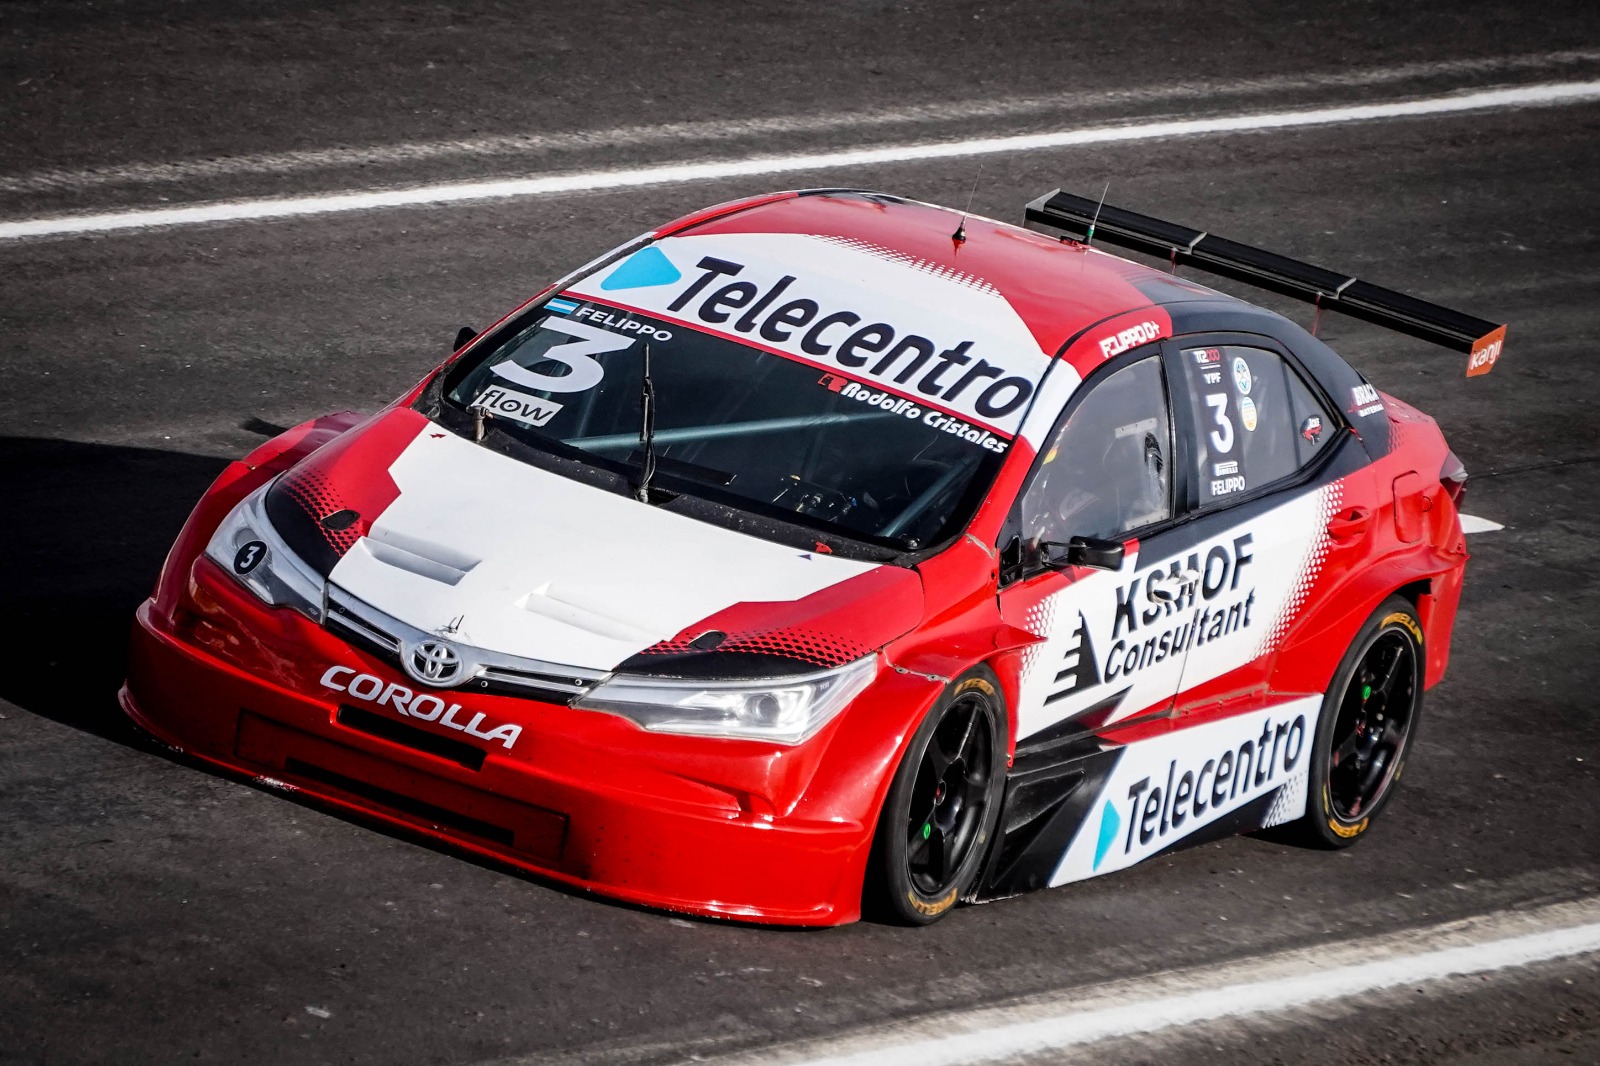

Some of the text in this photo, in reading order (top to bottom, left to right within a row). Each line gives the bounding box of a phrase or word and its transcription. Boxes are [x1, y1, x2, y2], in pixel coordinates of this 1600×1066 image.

[490, 315, 637, 393] 3
[576, 307, 673, 342] FELIPPO
[667, 255, 1034, 418] Telecentro
[1203, 372, 1221, 385] YPF
[841, 382, 1009, 454] Rodolfo Cristales
[1206, 392, 1234, 453] 3
[1211, 475, 1246, 496] FELIPPO
[239, 544, 260, 569] 3
[1104, 587, 1255, 685] Consultant
[319, 665, 523, 750] COROLLA
[1124, 714, 1306, 856] Telecentro
